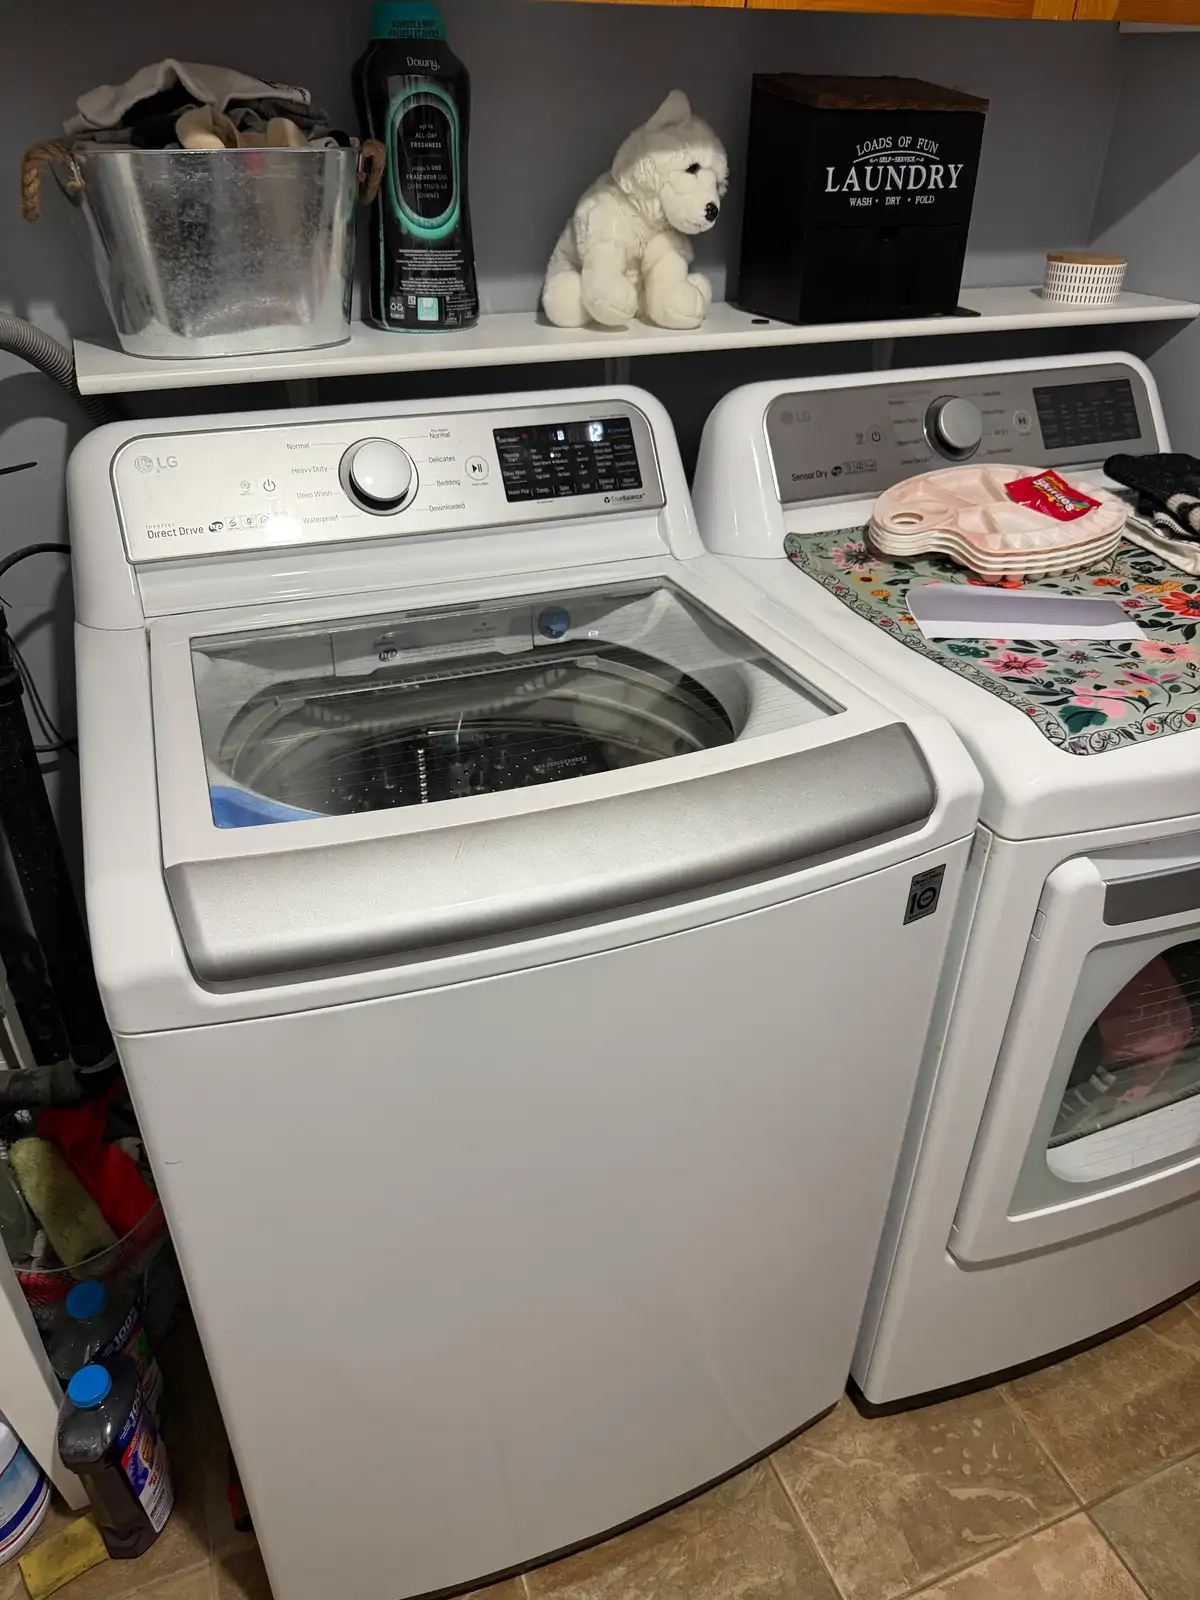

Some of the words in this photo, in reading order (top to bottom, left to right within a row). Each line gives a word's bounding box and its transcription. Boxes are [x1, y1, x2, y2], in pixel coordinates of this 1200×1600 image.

[406, 57, 438, 71] Downy
[410, 141, 442, 149] FRESHNESS
[856, 136, 893, 156] LOADS
[898, 136, 913, 147] OF
[917, 137, 939, 154] FUN
[825, 164, 964, 192] LAUNDRY
[849, 197, 873, 207] WASH
[885, 196, 902, 206] DRY
[915, 195, 936, 205] FOLD
[795, 411, 812, 423] LG
[429, 432, 451, 440] Normal
[286, 442, 310, 450] Normal
[156, 455, 178, 469] LG
[428, 456, 456, 464] Delicates
[291, 467, 312, 475] Heavy
[312, 465, 328, 474] Duty
[791, 472, 815, 482] Sensor
[815, 470, 828, 479] Dry
[436, 479, 461, 487] Bedding
[296, 492, 314, 501] Deep
[314, 490, 333, 498] Wash
[611, 493, 643, 502] TrueBalance
[428, 502, 466, 512] Downloaded
[301, 514, 339, 525] Waterproof
[145, 522, 175, 530] Inverter
[147, 529, 178, 539] Direct
[178, 526, 204, 537] Drive
[909, 886, 937, 914] 10
